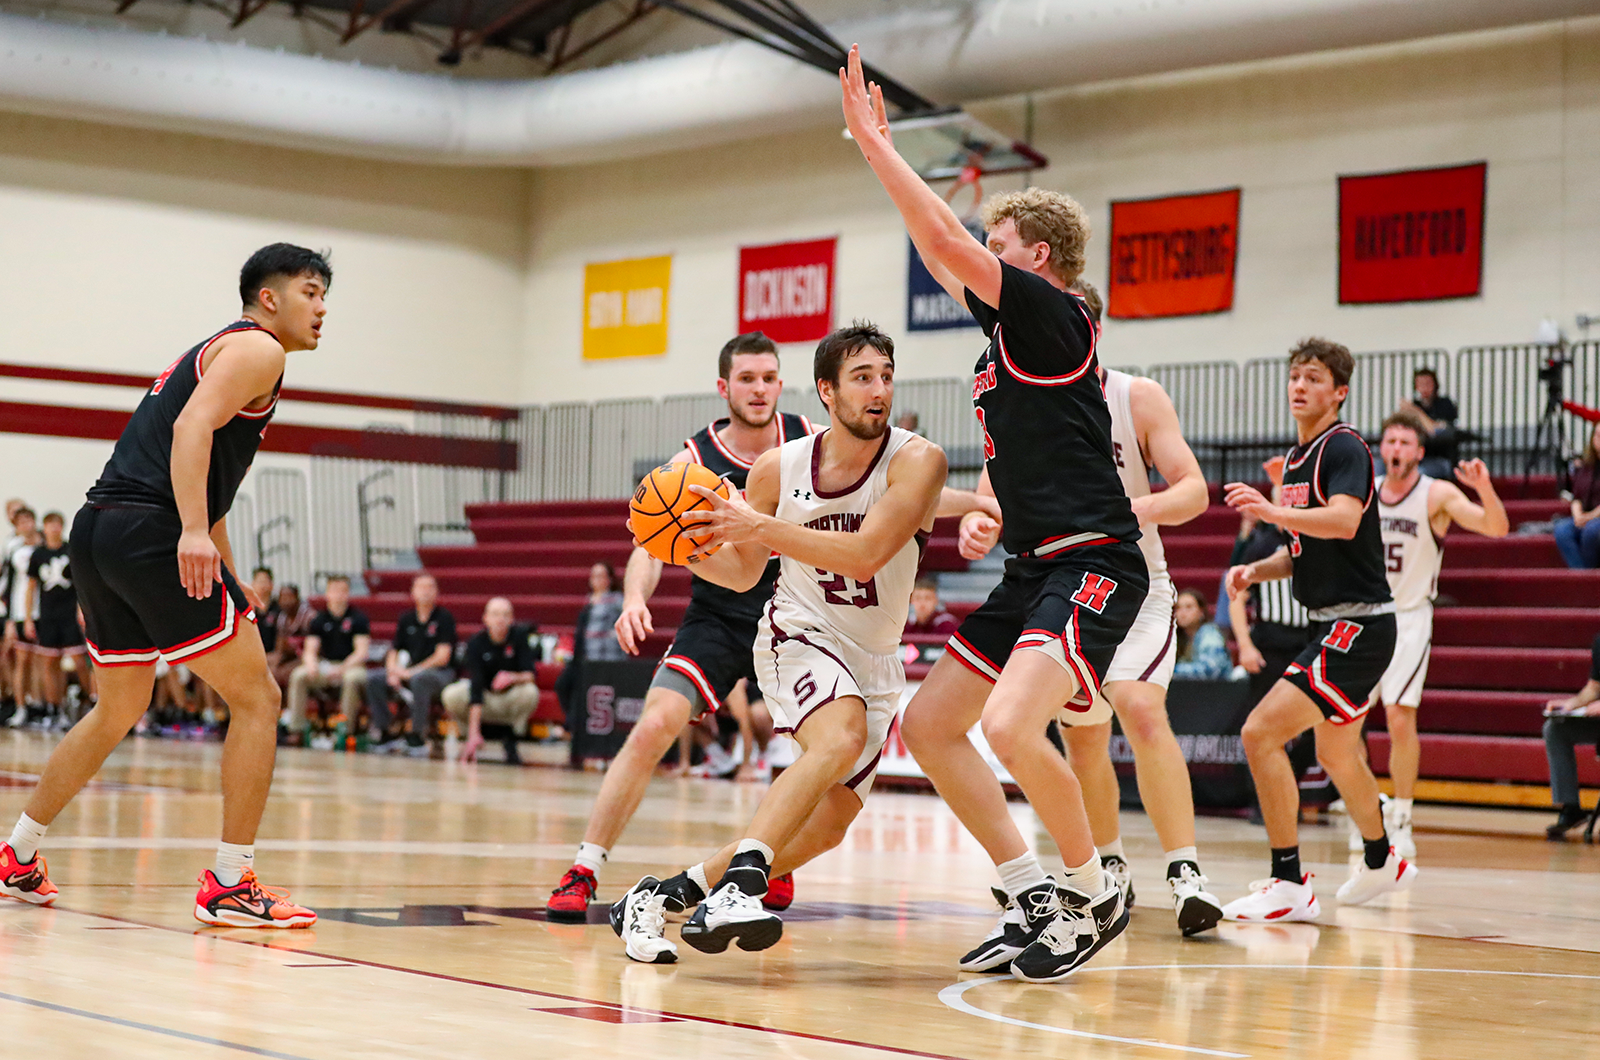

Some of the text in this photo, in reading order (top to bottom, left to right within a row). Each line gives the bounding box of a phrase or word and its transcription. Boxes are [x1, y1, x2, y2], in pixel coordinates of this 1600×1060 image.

[1117, 223, 1229, 284] GETTYSBURG
[1355, 208, 1466, 261] HAVERFORD
[743, 262, 828, 322] DICKINSON
[1070, 571, 1118, 615] H
[1320, 619, 1364, 654] H
[586, 685, 615, 735] S
[793, 669, 818, 709] S
